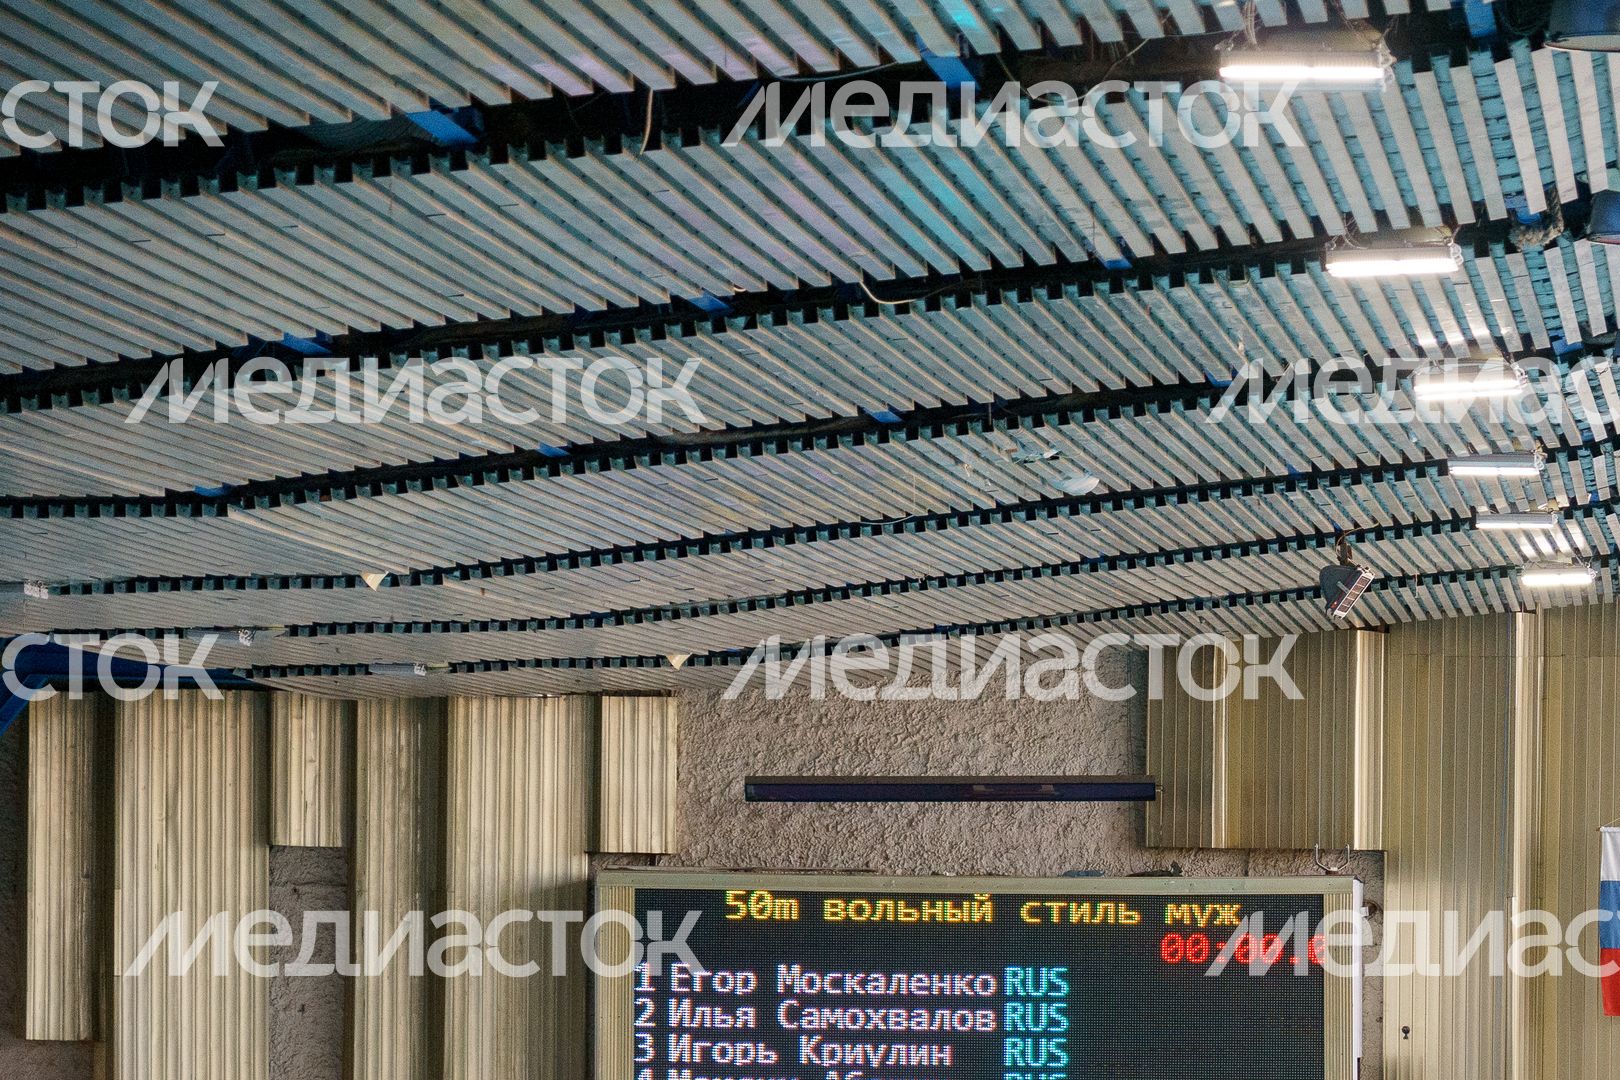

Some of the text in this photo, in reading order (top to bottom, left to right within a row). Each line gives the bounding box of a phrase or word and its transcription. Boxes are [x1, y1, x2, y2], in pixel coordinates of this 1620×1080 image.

[725, 889, 1243, 927] 50m вольный стиль муж
[634, 963, 1070, 997] 1 Егор Москаленко RUS
[634, 999, 1070, 1032] 2 Илья Самохвалов RUS
[634, 1034, 1069, 1068] 3 Игорь Криулин RUS
